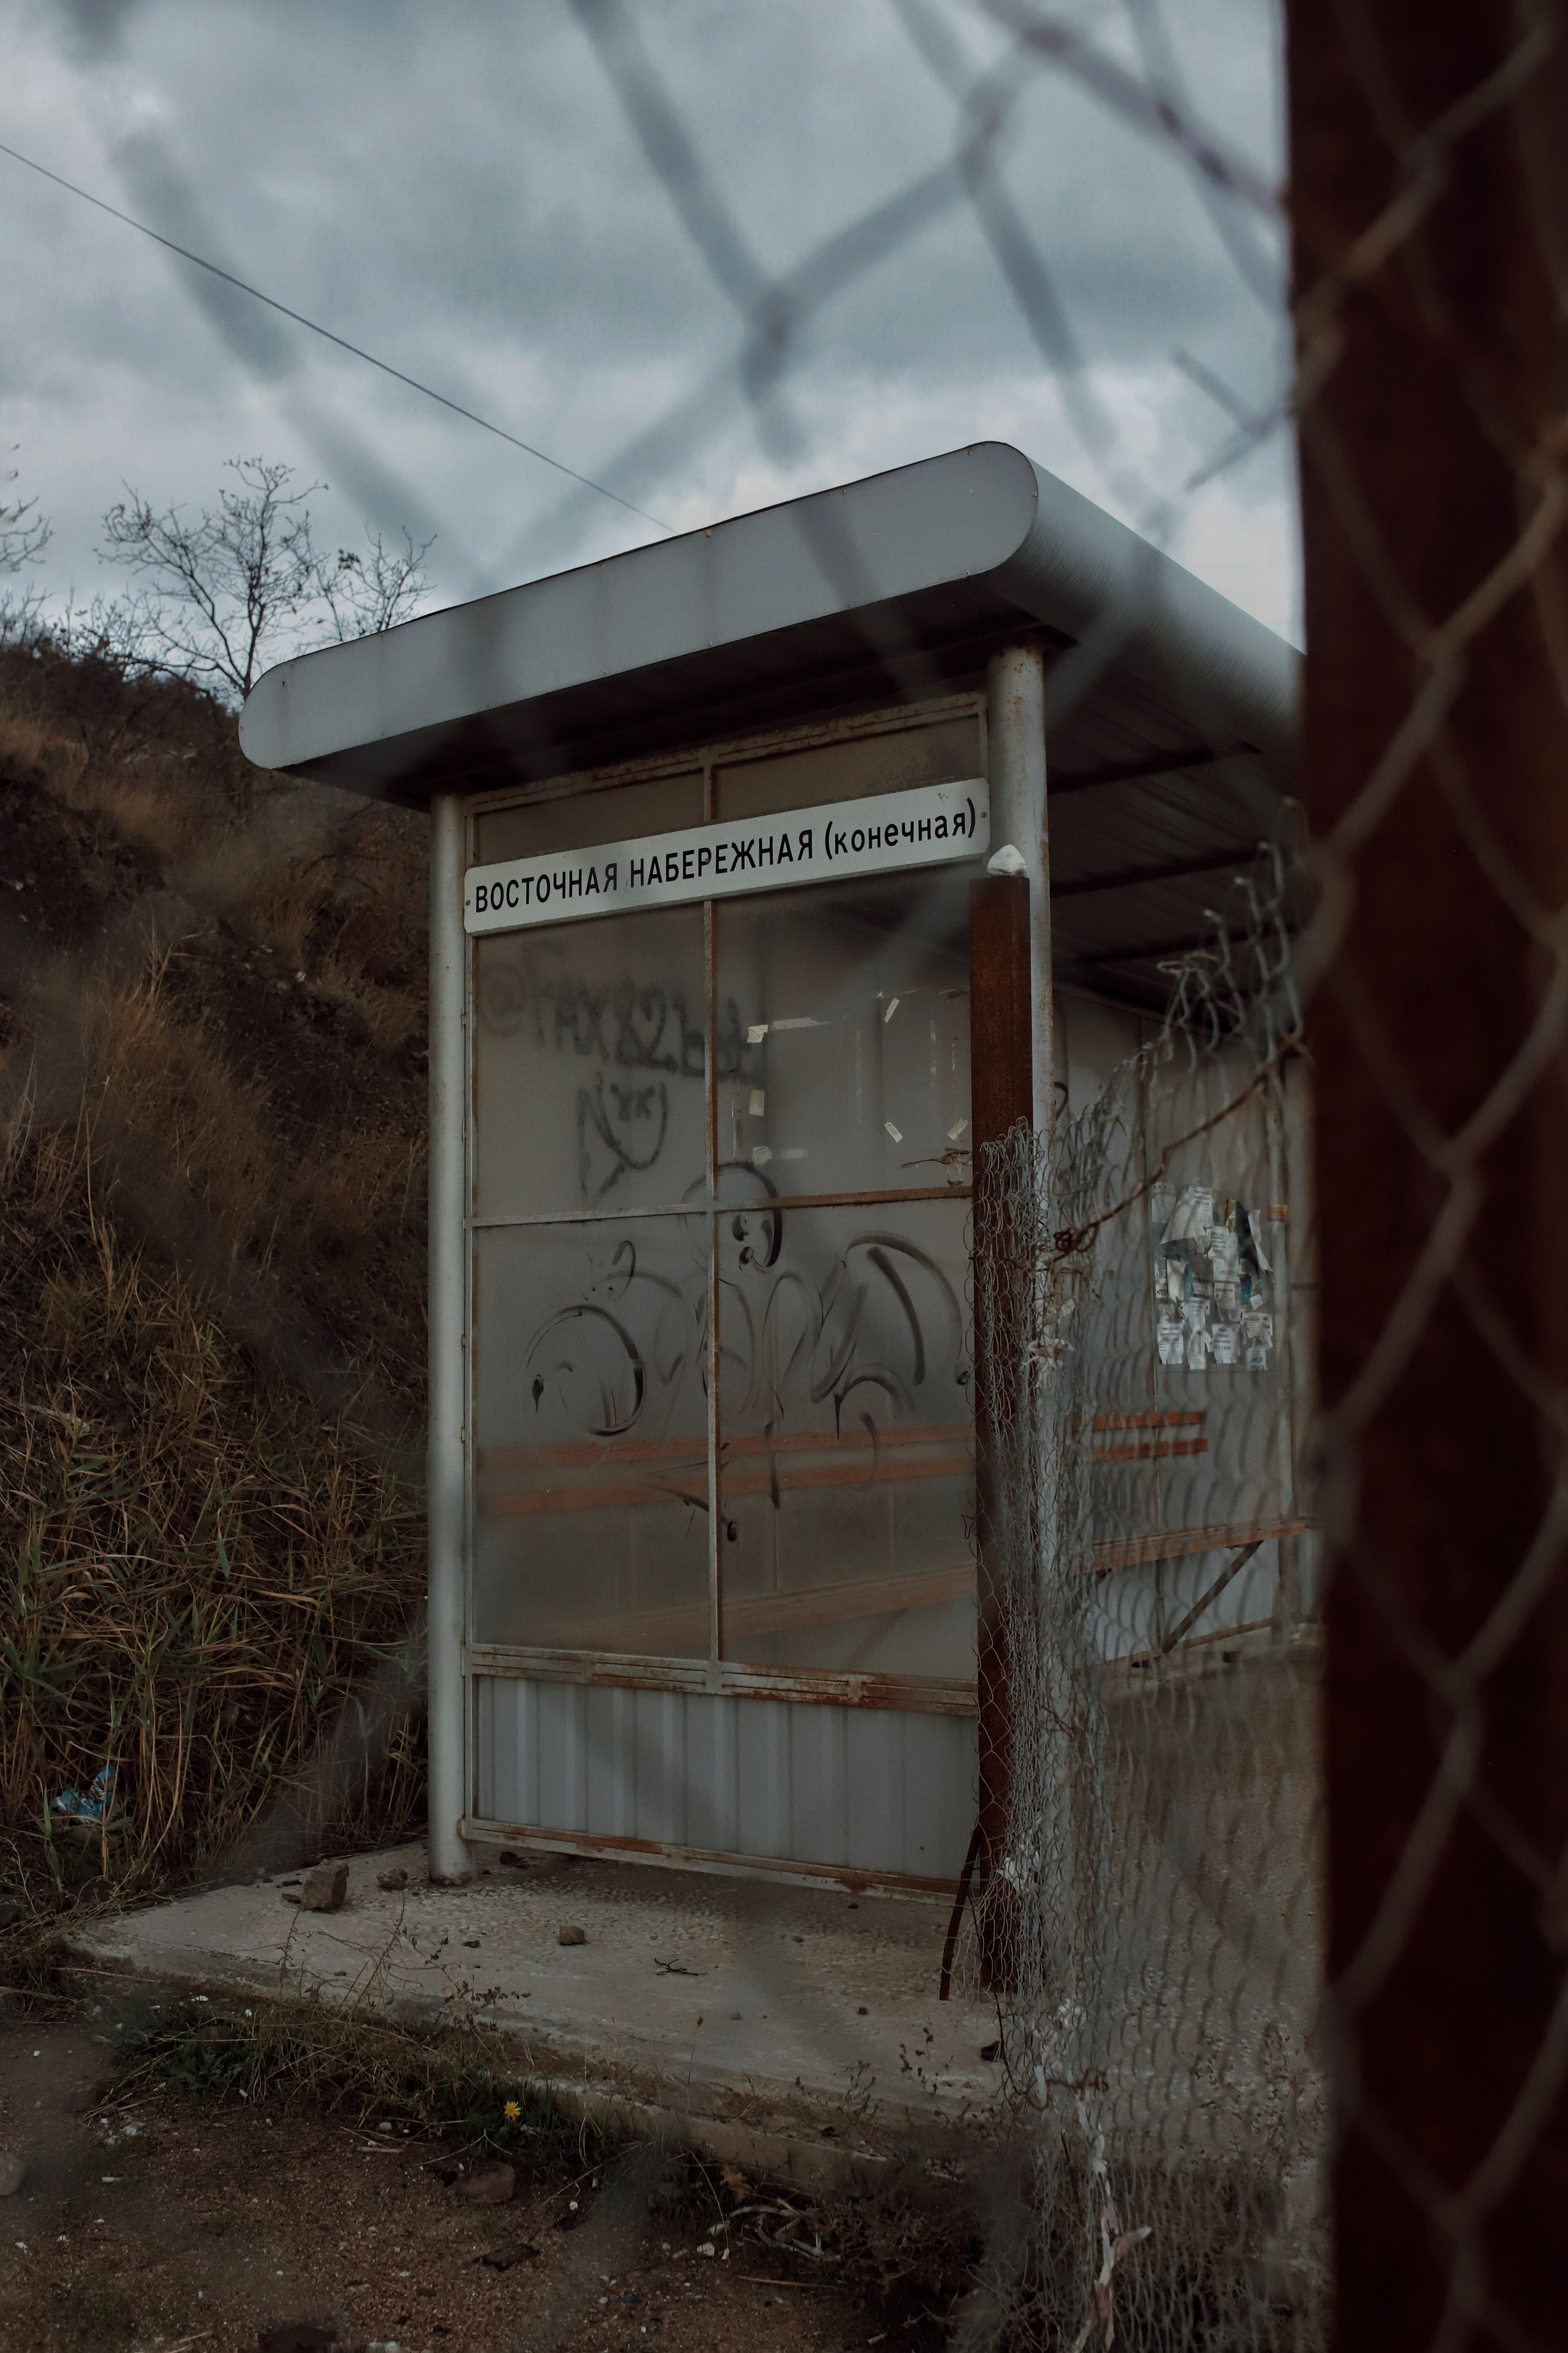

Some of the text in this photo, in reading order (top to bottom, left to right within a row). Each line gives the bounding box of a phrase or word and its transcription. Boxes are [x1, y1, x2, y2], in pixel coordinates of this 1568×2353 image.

[475, 798, 976, 913] ВОСТОЧНАЯ НАБЕРЕЖНАЯ (конечная)
